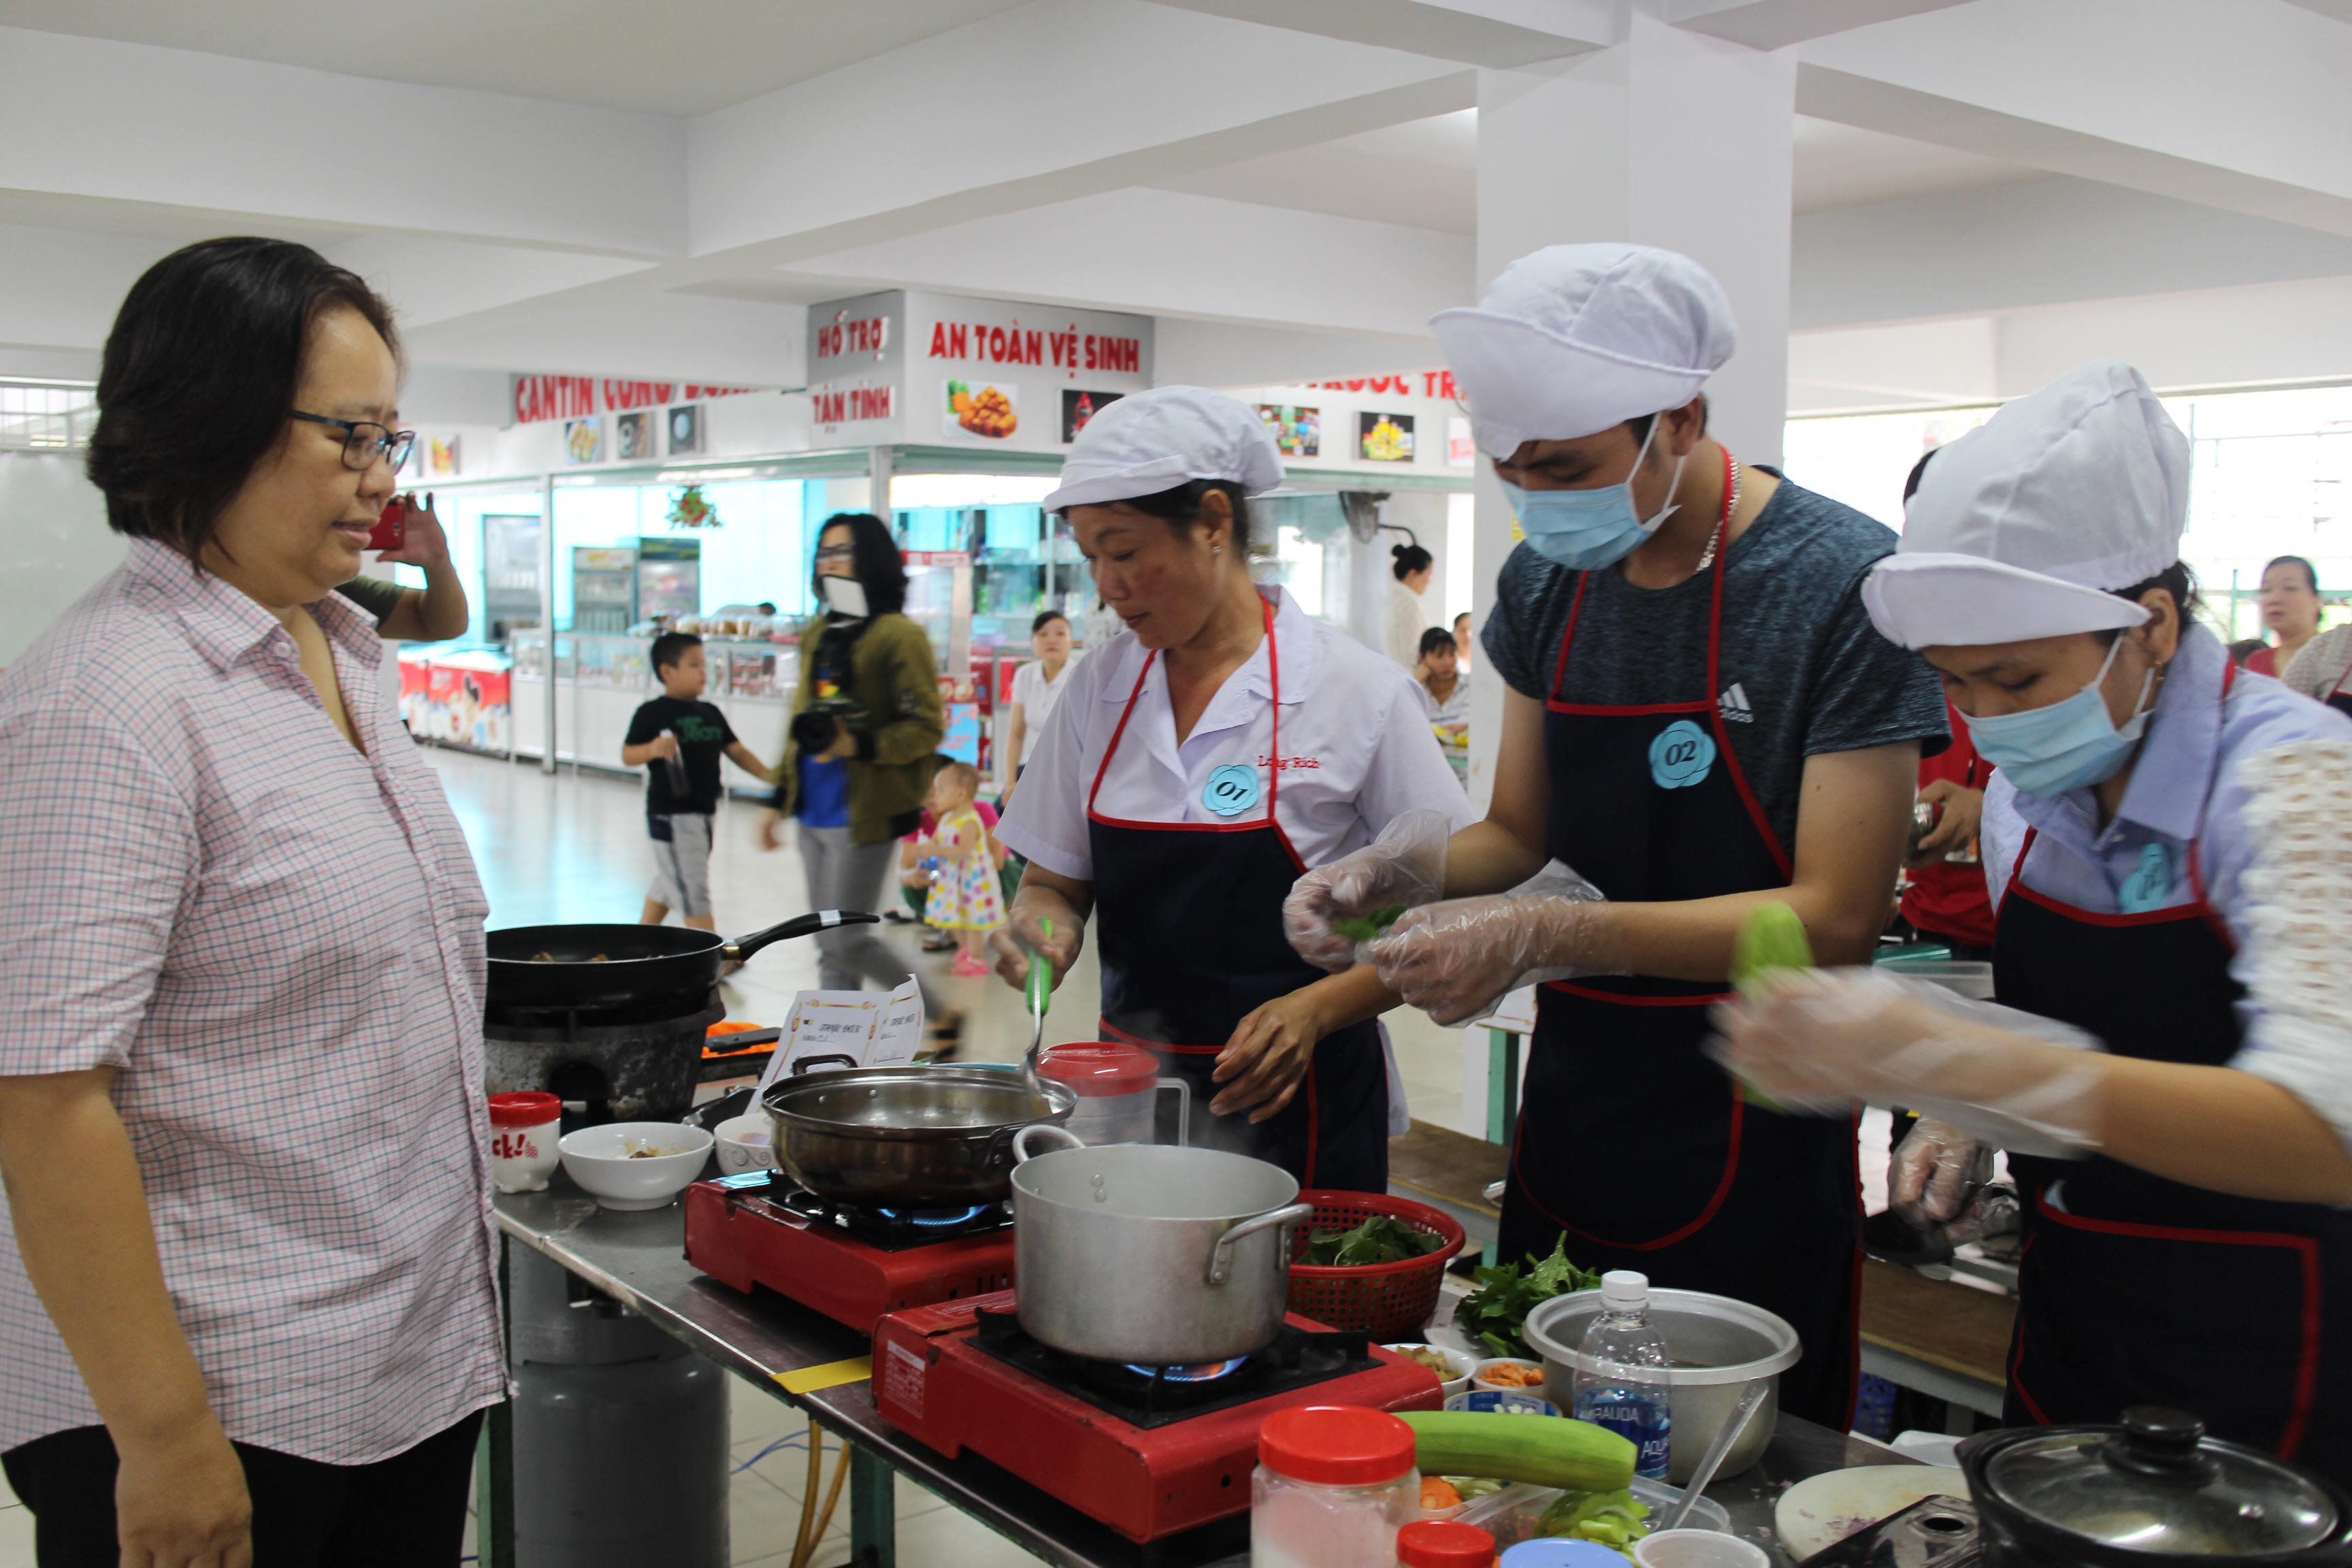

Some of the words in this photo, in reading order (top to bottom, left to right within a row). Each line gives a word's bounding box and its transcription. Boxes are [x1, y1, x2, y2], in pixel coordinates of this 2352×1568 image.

[929, 321, 967, 359] AN
[975, 318, 1043, 366] TOÀN
[1049, 323, 1078, 379] VỆ
[1085, 334, 1140, 373] SINH
[516, 375, 593, 424] CANTIN
[1666, 740, 1697, 766] 02
[1216, 781, 1249, 801] 01
